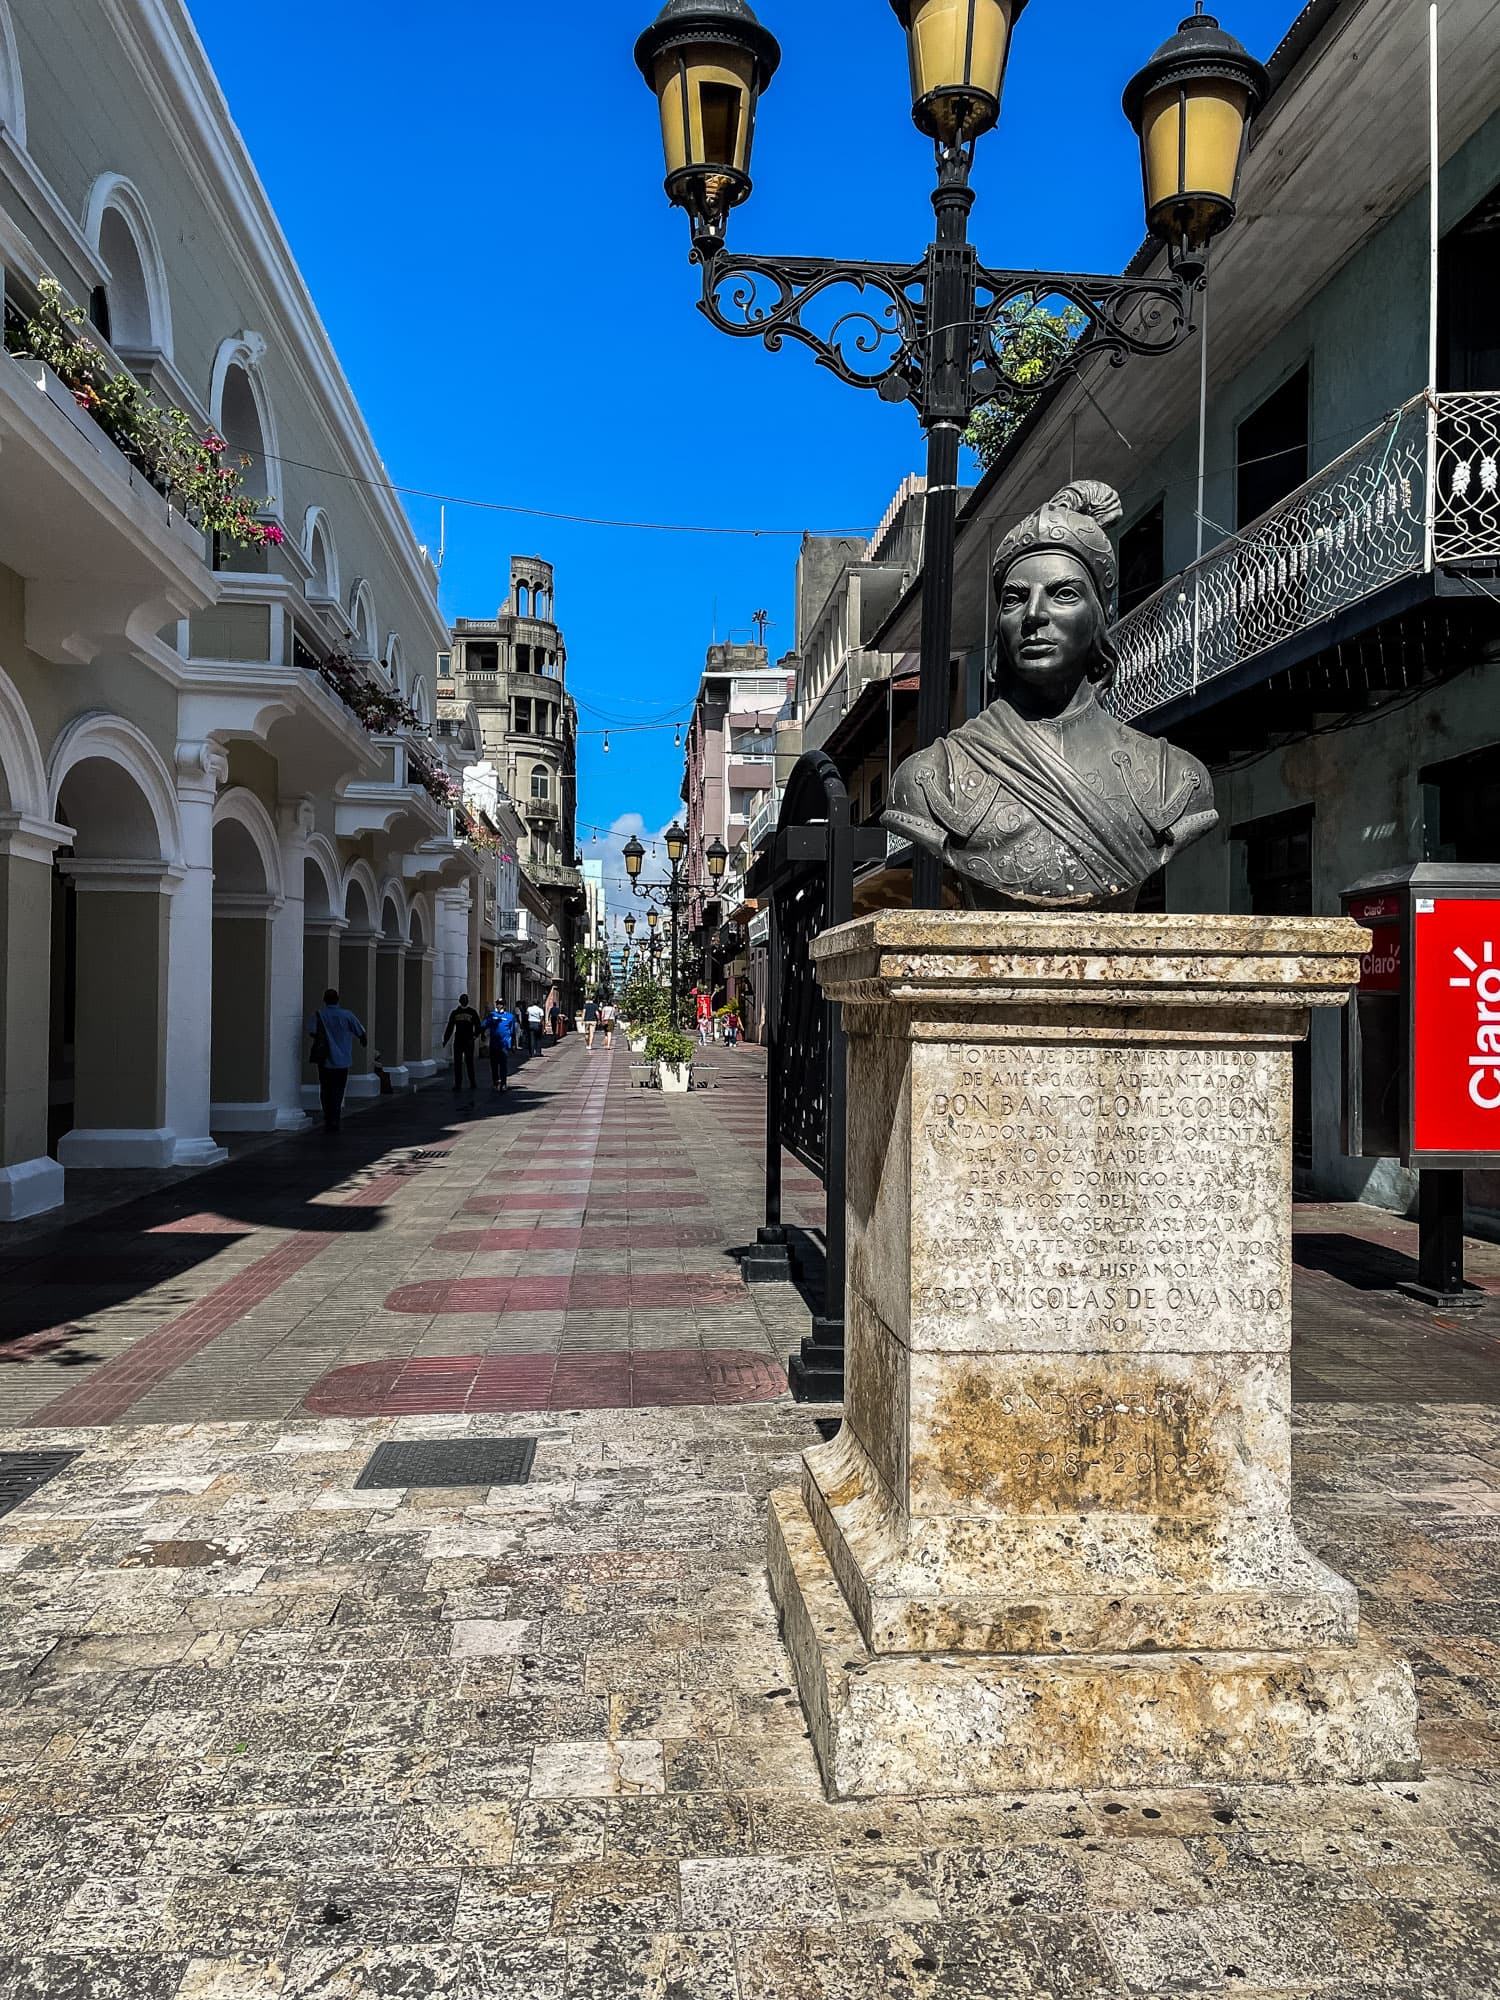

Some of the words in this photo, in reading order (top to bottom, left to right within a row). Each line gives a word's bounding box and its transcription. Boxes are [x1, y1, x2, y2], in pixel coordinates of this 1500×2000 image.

[1362, 954, 1395, 974] Claro
[1468, 968, 1500, 1109] Claro
[948, 1046, 1055, 1064] HOMENAJE
[1066, 1050, 1095, 1064] DEL
[1103, 1050, 1171, 1066] PRIMER
[1178, 1051, 1257, 1066] CABILDO
[962, 1072, 983, 1087] DE
[1083, 1073, 1106, 1088] AL
[1116, 1073, 1245, 1089] ADELANTADO
[934, 1094, 991, 1118] DON
[1001, 1095, 1170, 1118] BARTOLOME
[1177, 1096, 1272, 1120] COLON
[925, 1125, 1027, 1140] FUNDADOR
[1035, 1125, 1058, 1140] EN
[1066, 1126, 1088, 1140] LA
[1097, 1126, 1176, 1142] MARGEN
[1183, 1126, 1280, 1143] ORIENTAL
[965, 1148, 997, 1163] DEL
[1126, 1149, 1146, 1164] DE
[1155, 1150, 1177, 1164] LA
[970, 1170, 989, 1185] DE
[998, 1171, 1064, 1186] SANTO
[1073, 1171, 1168, 1187] DOMINGO
[964, 1193, 974, 1208] 5
[982, 1193, 1004, 1208] DE
[1012, 1193, 1091, 1209] AGOSTO
[1100, 1194, 1129, 1209] DEL
[1139, 1191, 1182, 1210] AÑO
[956, 1216, 1006, 1231] PARA
[1083, 1217, 1114, 1232] SER
[952, 1239, 998, 1254] ESTA
[1006, 1240, 1065, 1254] PARTE
[1073, 1240, 1109, 1255] POR
[1118, 1241, 1138, 1255] EL
[992, 1262, 1012, 1277] DE
[919, 1287, 987, 1310] FREY
[1000, 1287, 1117, 1310] NICOLAS
[1127, 1288, 1156, 1309] DE
[1166, 1288, 1283, 1310] OVANDO
[1054, 1318, 1073, 1332] EL
